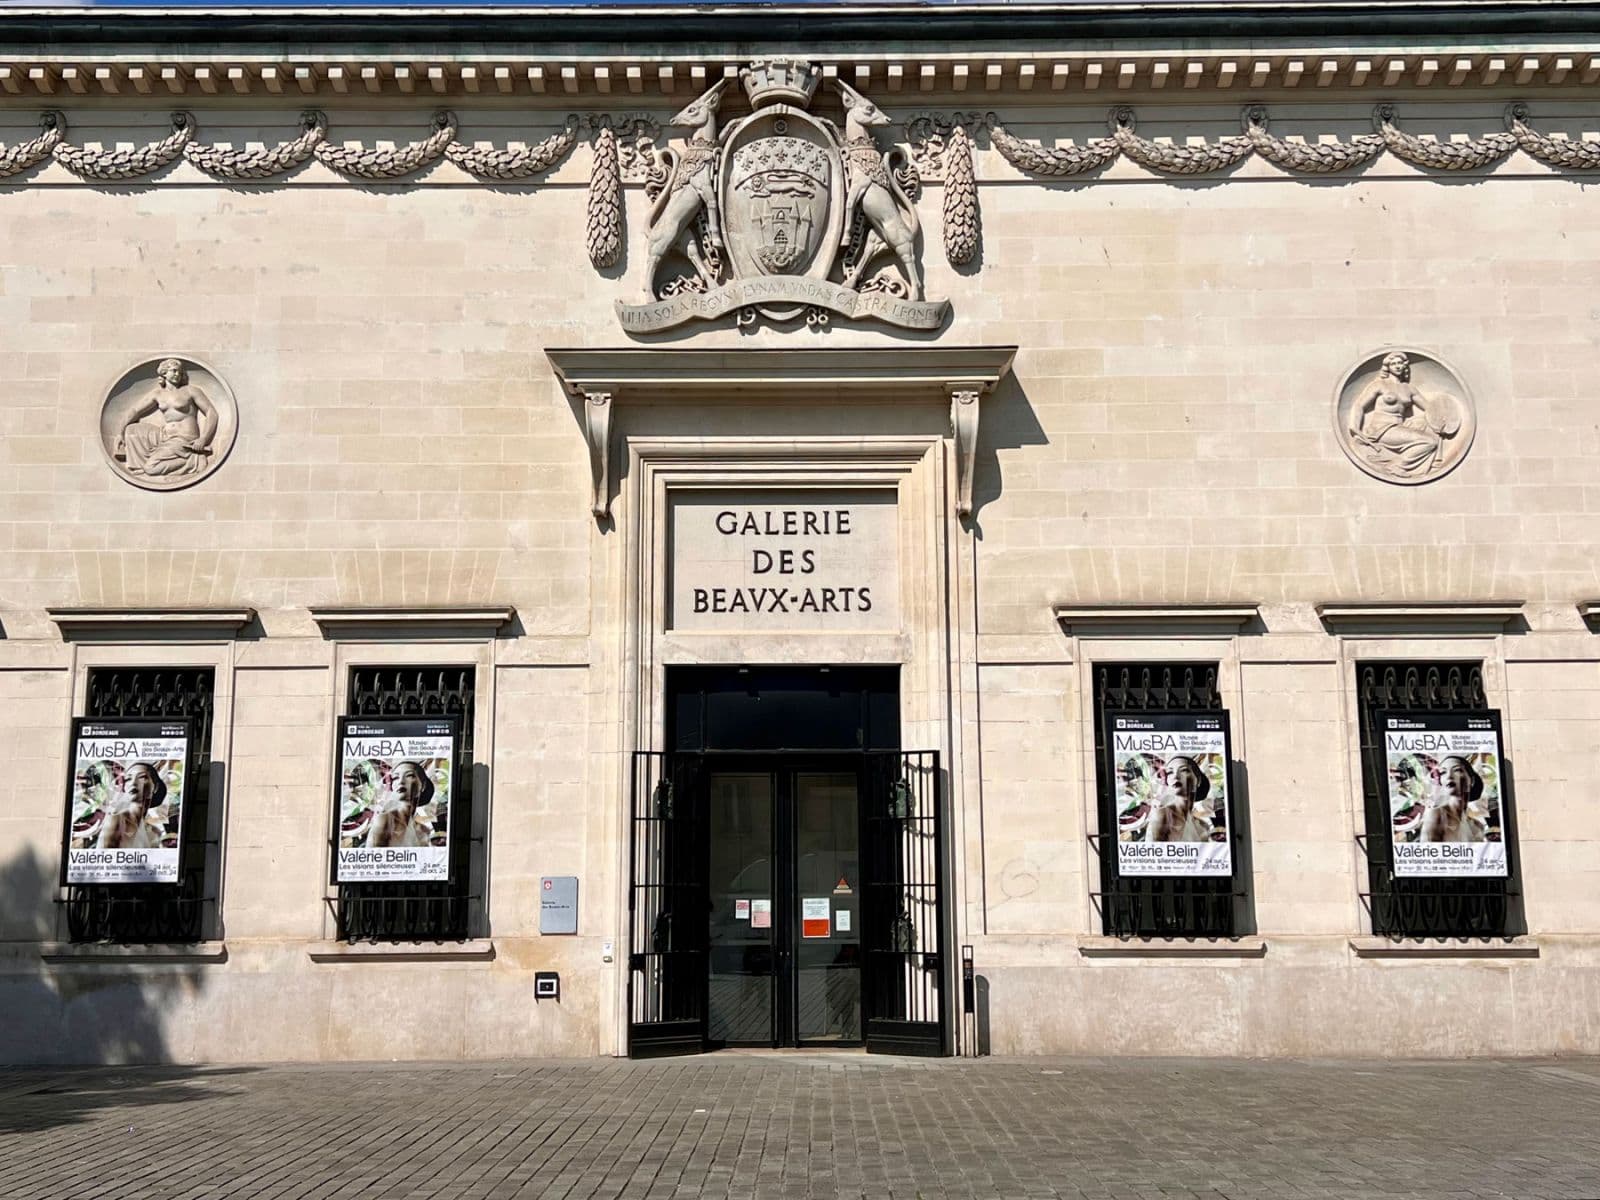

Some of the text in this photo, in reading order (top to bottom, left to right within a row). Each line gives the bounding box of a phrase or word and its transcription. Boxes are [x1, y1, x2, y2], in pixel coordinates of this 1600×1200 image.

[715, 510, 851, 535] GALERIE
[752, 549, 815, 574] DES
[80, 741, 139, 757] MusBA
[345, 740, 406, 756] MusBA
[1116, 735, 1177, 751] MusBA
[1388, 735, 1450, 751] MusBA
[70, 851, 148, 863] Valérie Belin
[339, 850, 417, 863] Valérie Belin
[1119, 844, 1199, 857] Valérie Belin
[1394, 845, 1474, 858] Valérie Belin
